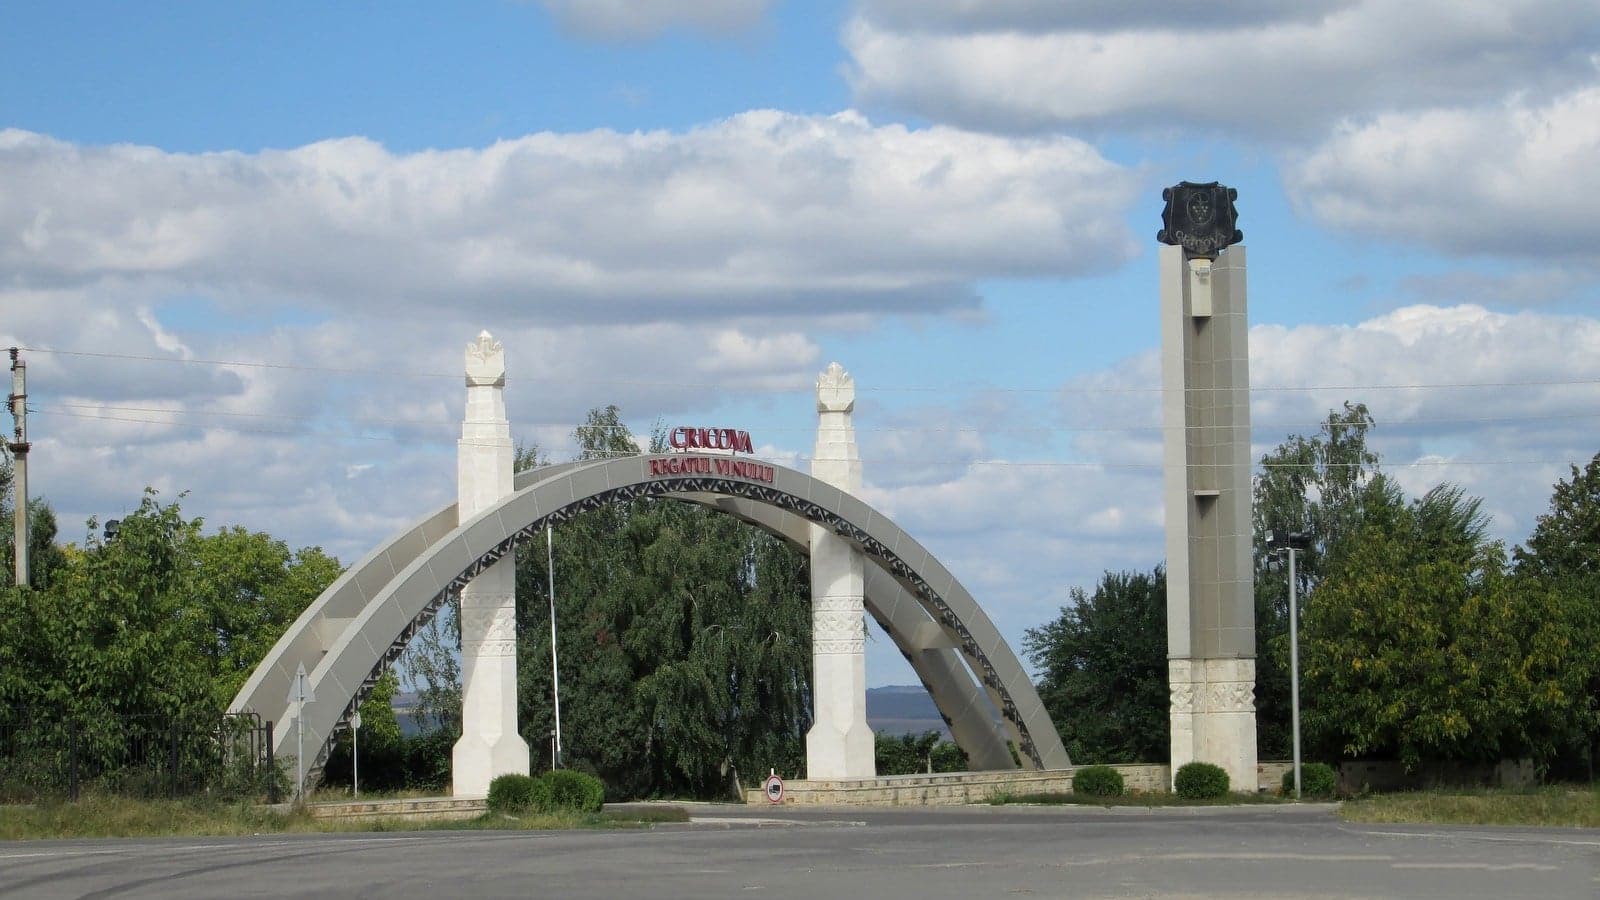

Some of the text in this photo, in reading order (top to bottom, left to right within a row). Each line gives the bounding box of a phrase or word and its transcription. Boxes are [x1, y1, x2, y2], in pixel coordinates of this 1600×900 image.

[669, 427, 754, 454] CRICOVA
[649, 458, 774, 483] REGATUL VINULUI
